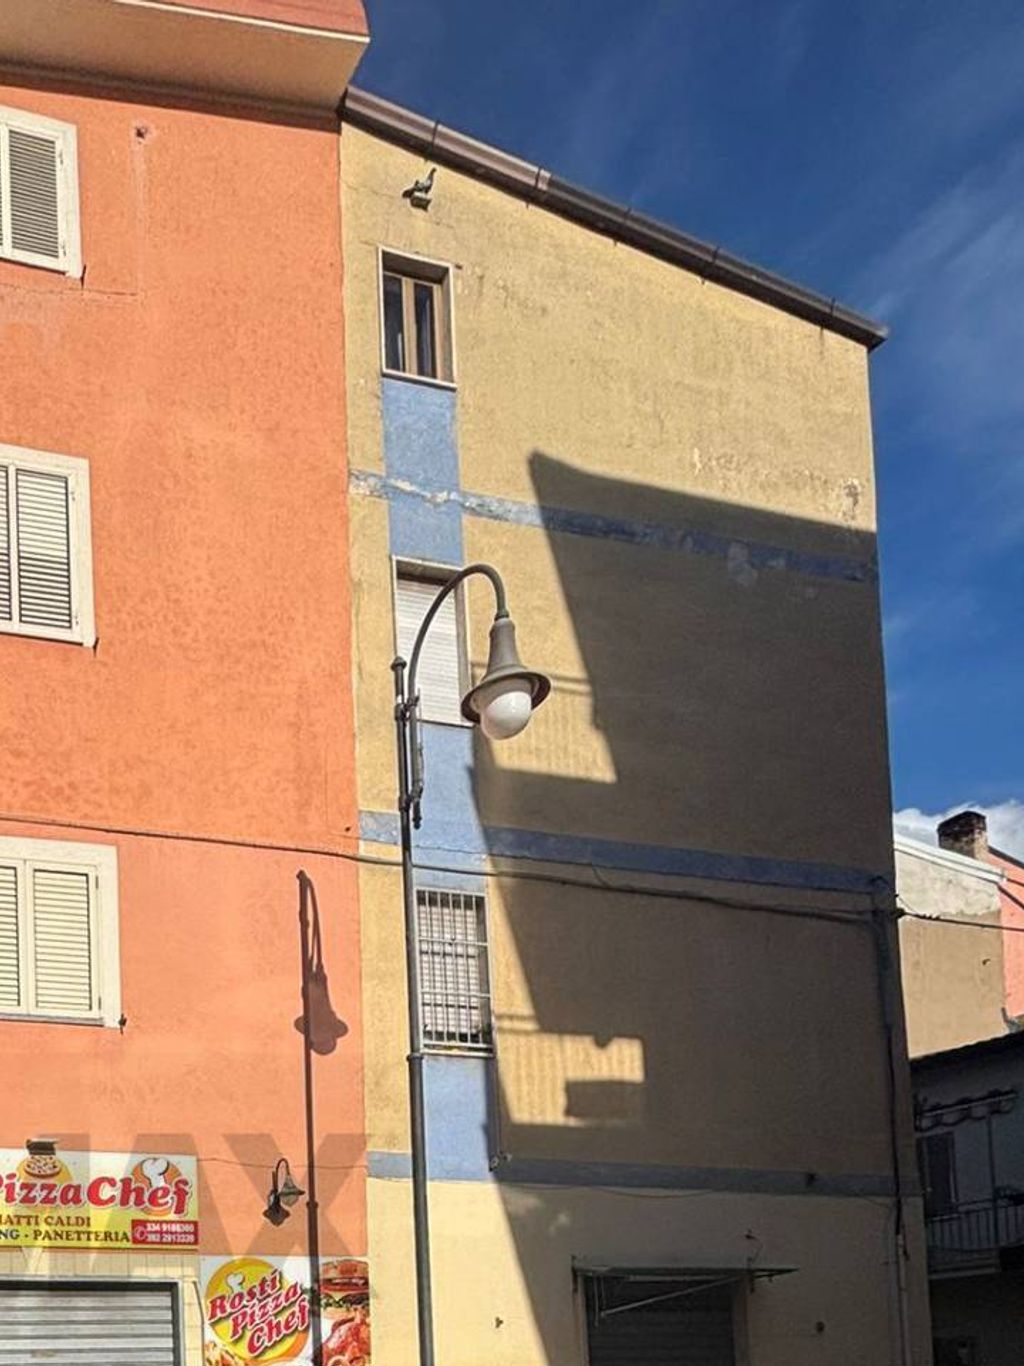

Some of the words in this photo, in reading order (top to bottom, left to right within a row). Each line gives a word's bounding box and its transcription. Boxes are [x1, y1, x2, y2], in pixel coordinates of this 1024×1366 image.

[87, 1176, 191, 1215] Chef
[33, 1229, 130, 1243] PANETTERIA
[44, 1215, 91, 1228] CALDI
[207, 1267, 280, 1322] Rosti
[230, 1281, 299, 1340] Pizza
[247, 1296, 308, 1354] Chef
